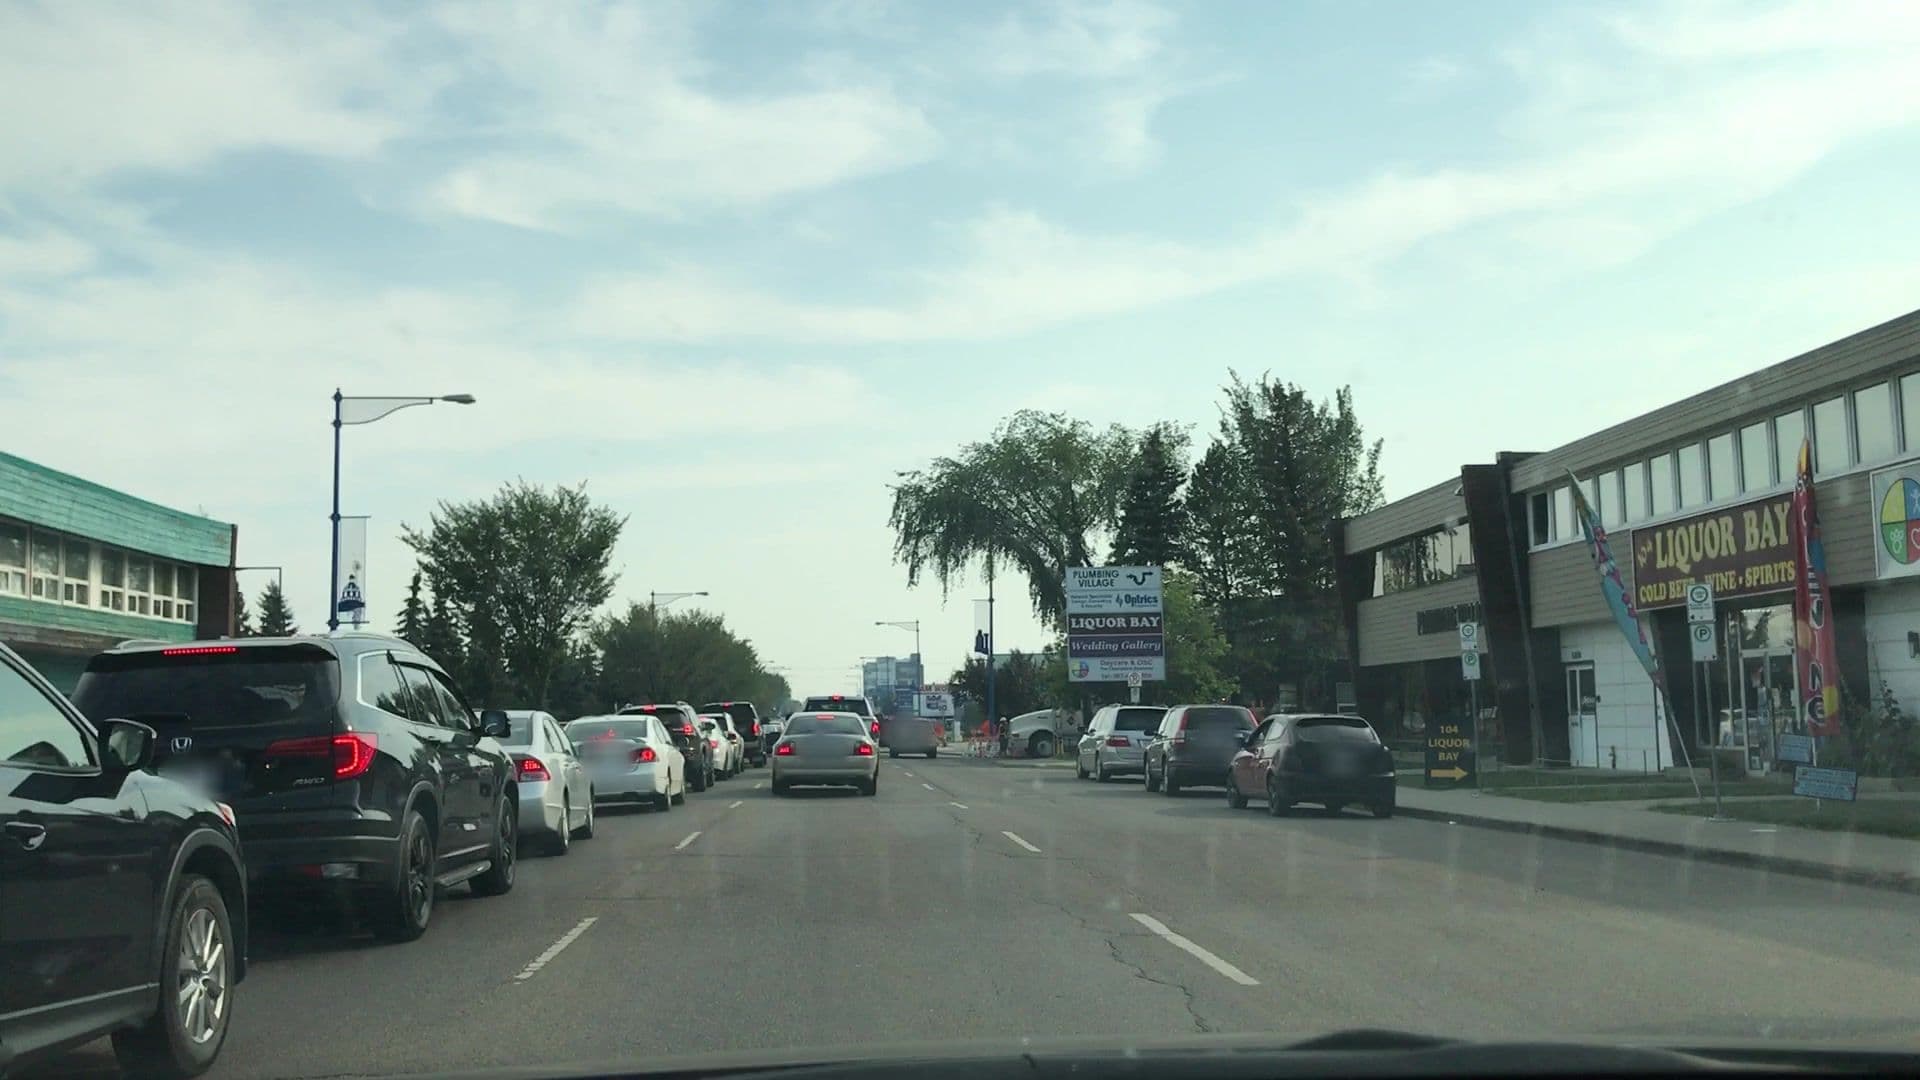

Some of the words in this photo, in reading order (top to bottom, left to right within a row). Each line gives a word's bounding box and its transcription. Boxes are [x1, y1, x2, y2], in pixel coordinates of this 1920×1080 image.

[1655, 515, 1737, 574] LIQUOR
[1744, 501, 1791, 552] BAY
[1073, 570, 1119, 579] PLUMBING
[1078, 579, 1115, 588] VILLAGE
[1639, 580, 1666, 603] COLD
[1744, 560, 1796, 589] SPIRITS
[1124, 594, 1159, 607] Optrics
[1071, 617, 1126, 629] LIQUOR
[1130, 617, 1160, 626] BAY
[1071, 641, 1119, 651] Wedding
[1121, 641, 1161, 651] Gallery
[1439, 725, 1459, 735] 104
[1428, 739, 1470, 749] LIQUOR
[1438, 752, 1460, 761] BAY
